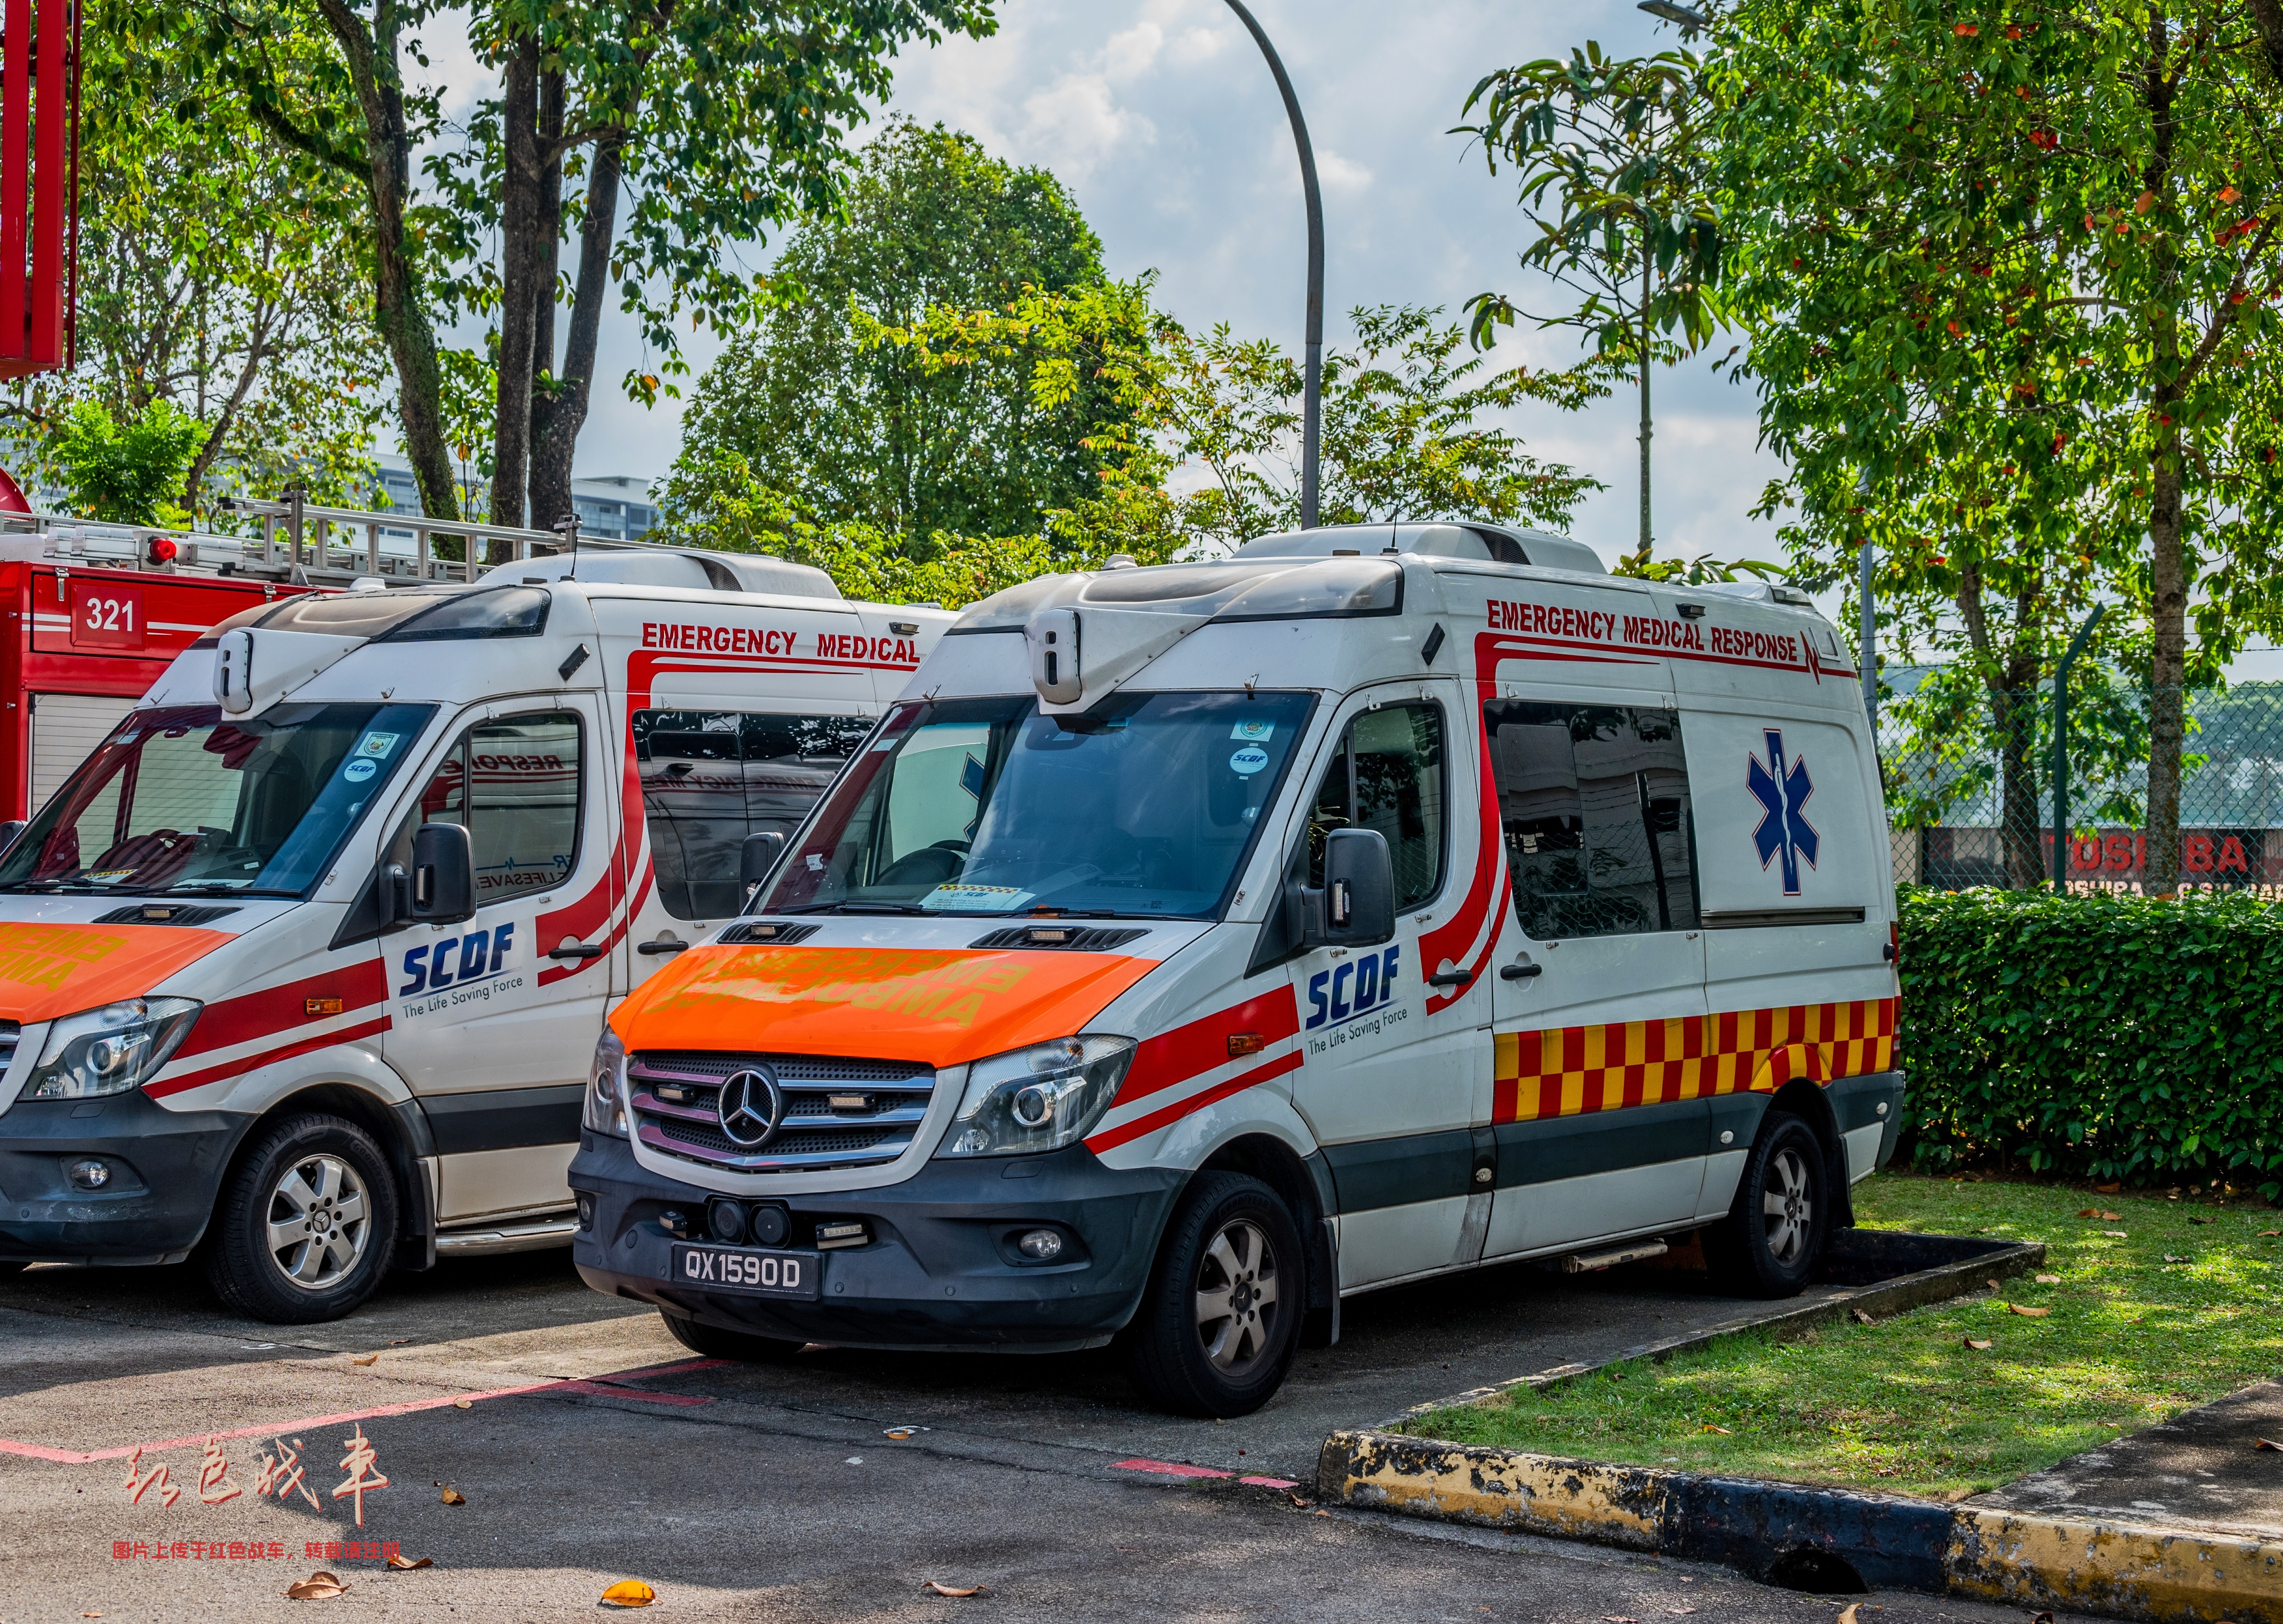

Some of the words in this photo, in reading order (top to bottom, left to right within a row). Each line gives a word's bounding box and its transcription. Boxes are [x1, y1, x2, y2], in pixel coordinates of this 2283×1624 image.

[86, 598, 132, 632] 321
[1486, 599, 1616, 641] EMERGENCY
[1623, 615, 1705, 651] MEDICAL
[1711, 627, 1798, 662] RESPONSE
[642, 622, 797, 655] EMERGENCY
[817, 633, 921, 663] MEDICAL
[399, 922, 514, 997] SCDF
[403, 1003, 424, 1018] The
[427, 996, 447, 1012] Life
[452, 986, 490, 1005] Saving
[493, 977, 523, 993] Force
[1305, 944, 1399, 1030] SCDF
[1309, 1037, 1326, 1055] The
[1329, 1028, 1346, 1048] Life
[1349, 1019, 1380, 1040] Saving
[1383, 1008, 1407, 1026] Force
